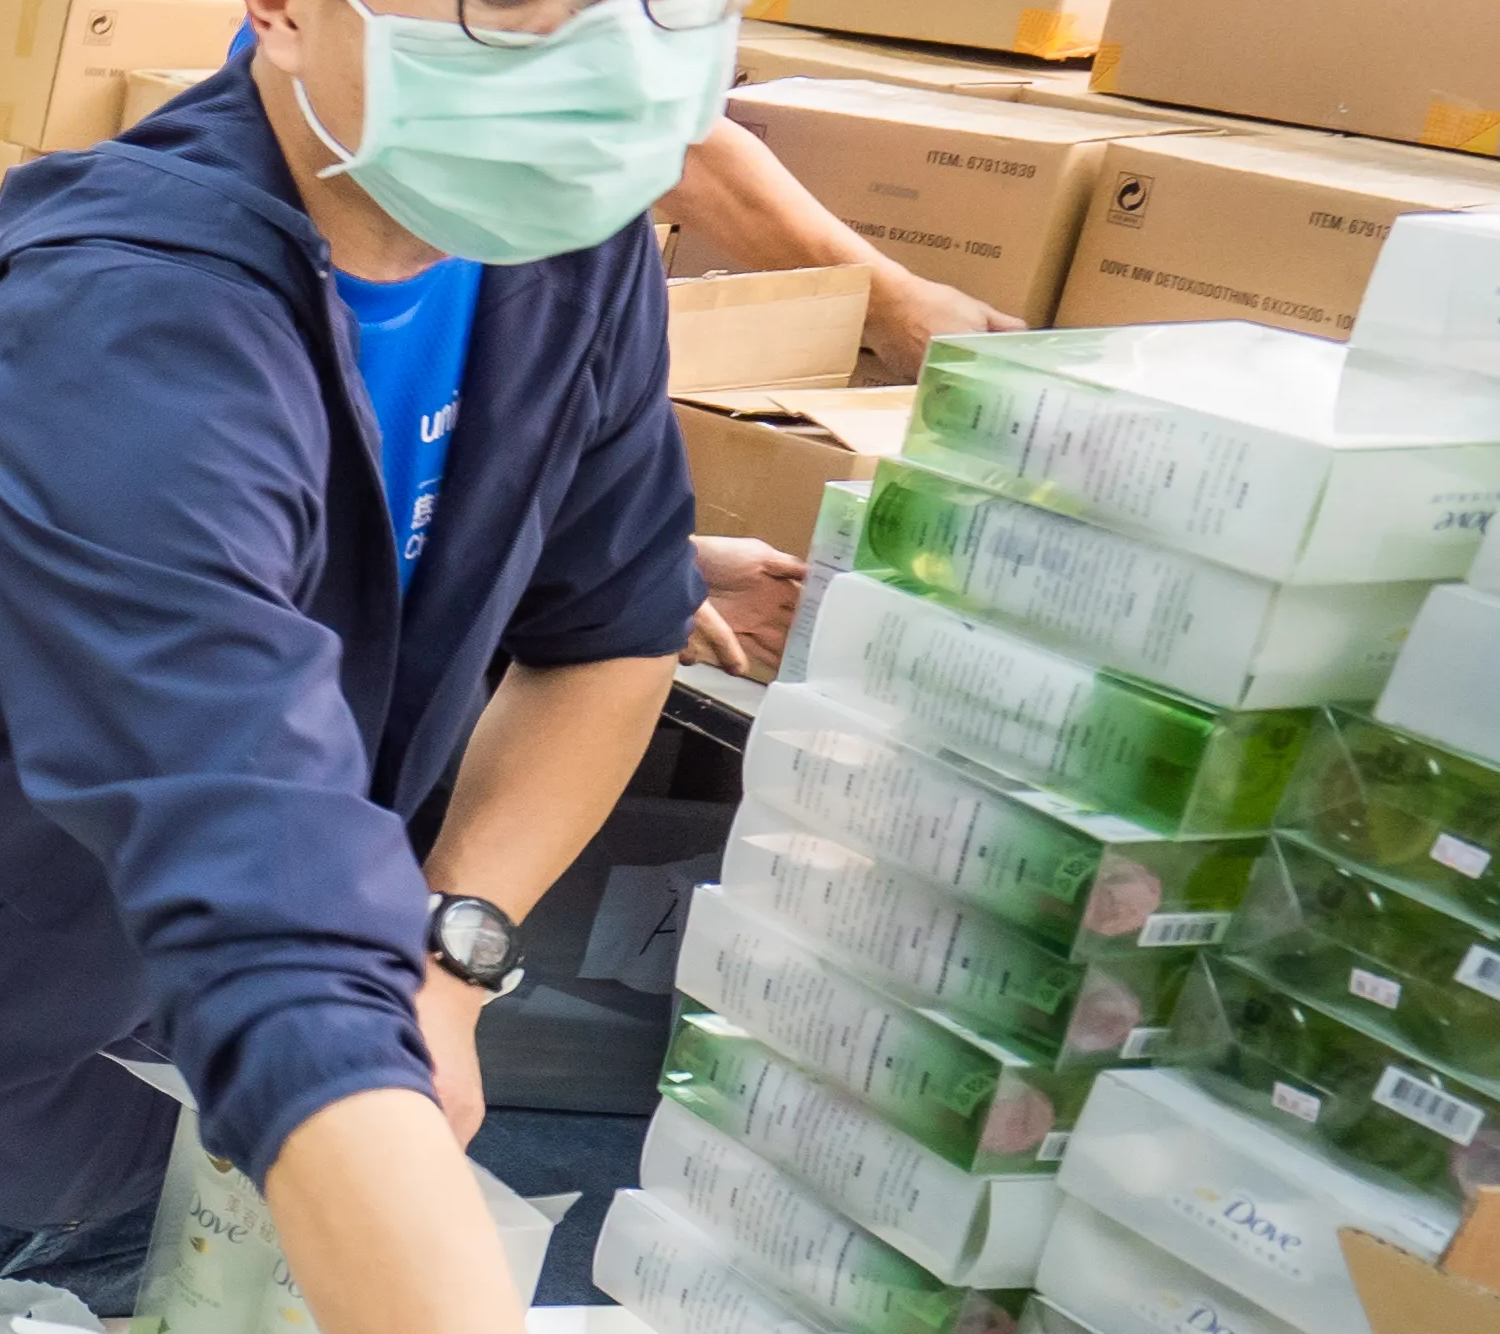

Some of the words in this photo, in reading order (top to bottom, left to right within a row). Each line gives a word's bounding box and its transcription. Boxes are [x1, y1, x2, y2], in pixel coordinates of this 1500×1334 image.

[926, 149, 964, 169] ITEM:
[1308, 210, 1346, 232] ITEM:
[1349, 216, 1392, 241] 67913
[1099, 258, 1131, 280] DOVE
[1131, 266, 1155, 285] MW
[420, 389, 461, 444] uni
[1434, 510, 1494, 535] ove
[1223, 1198, 1302, 1253] Dove
